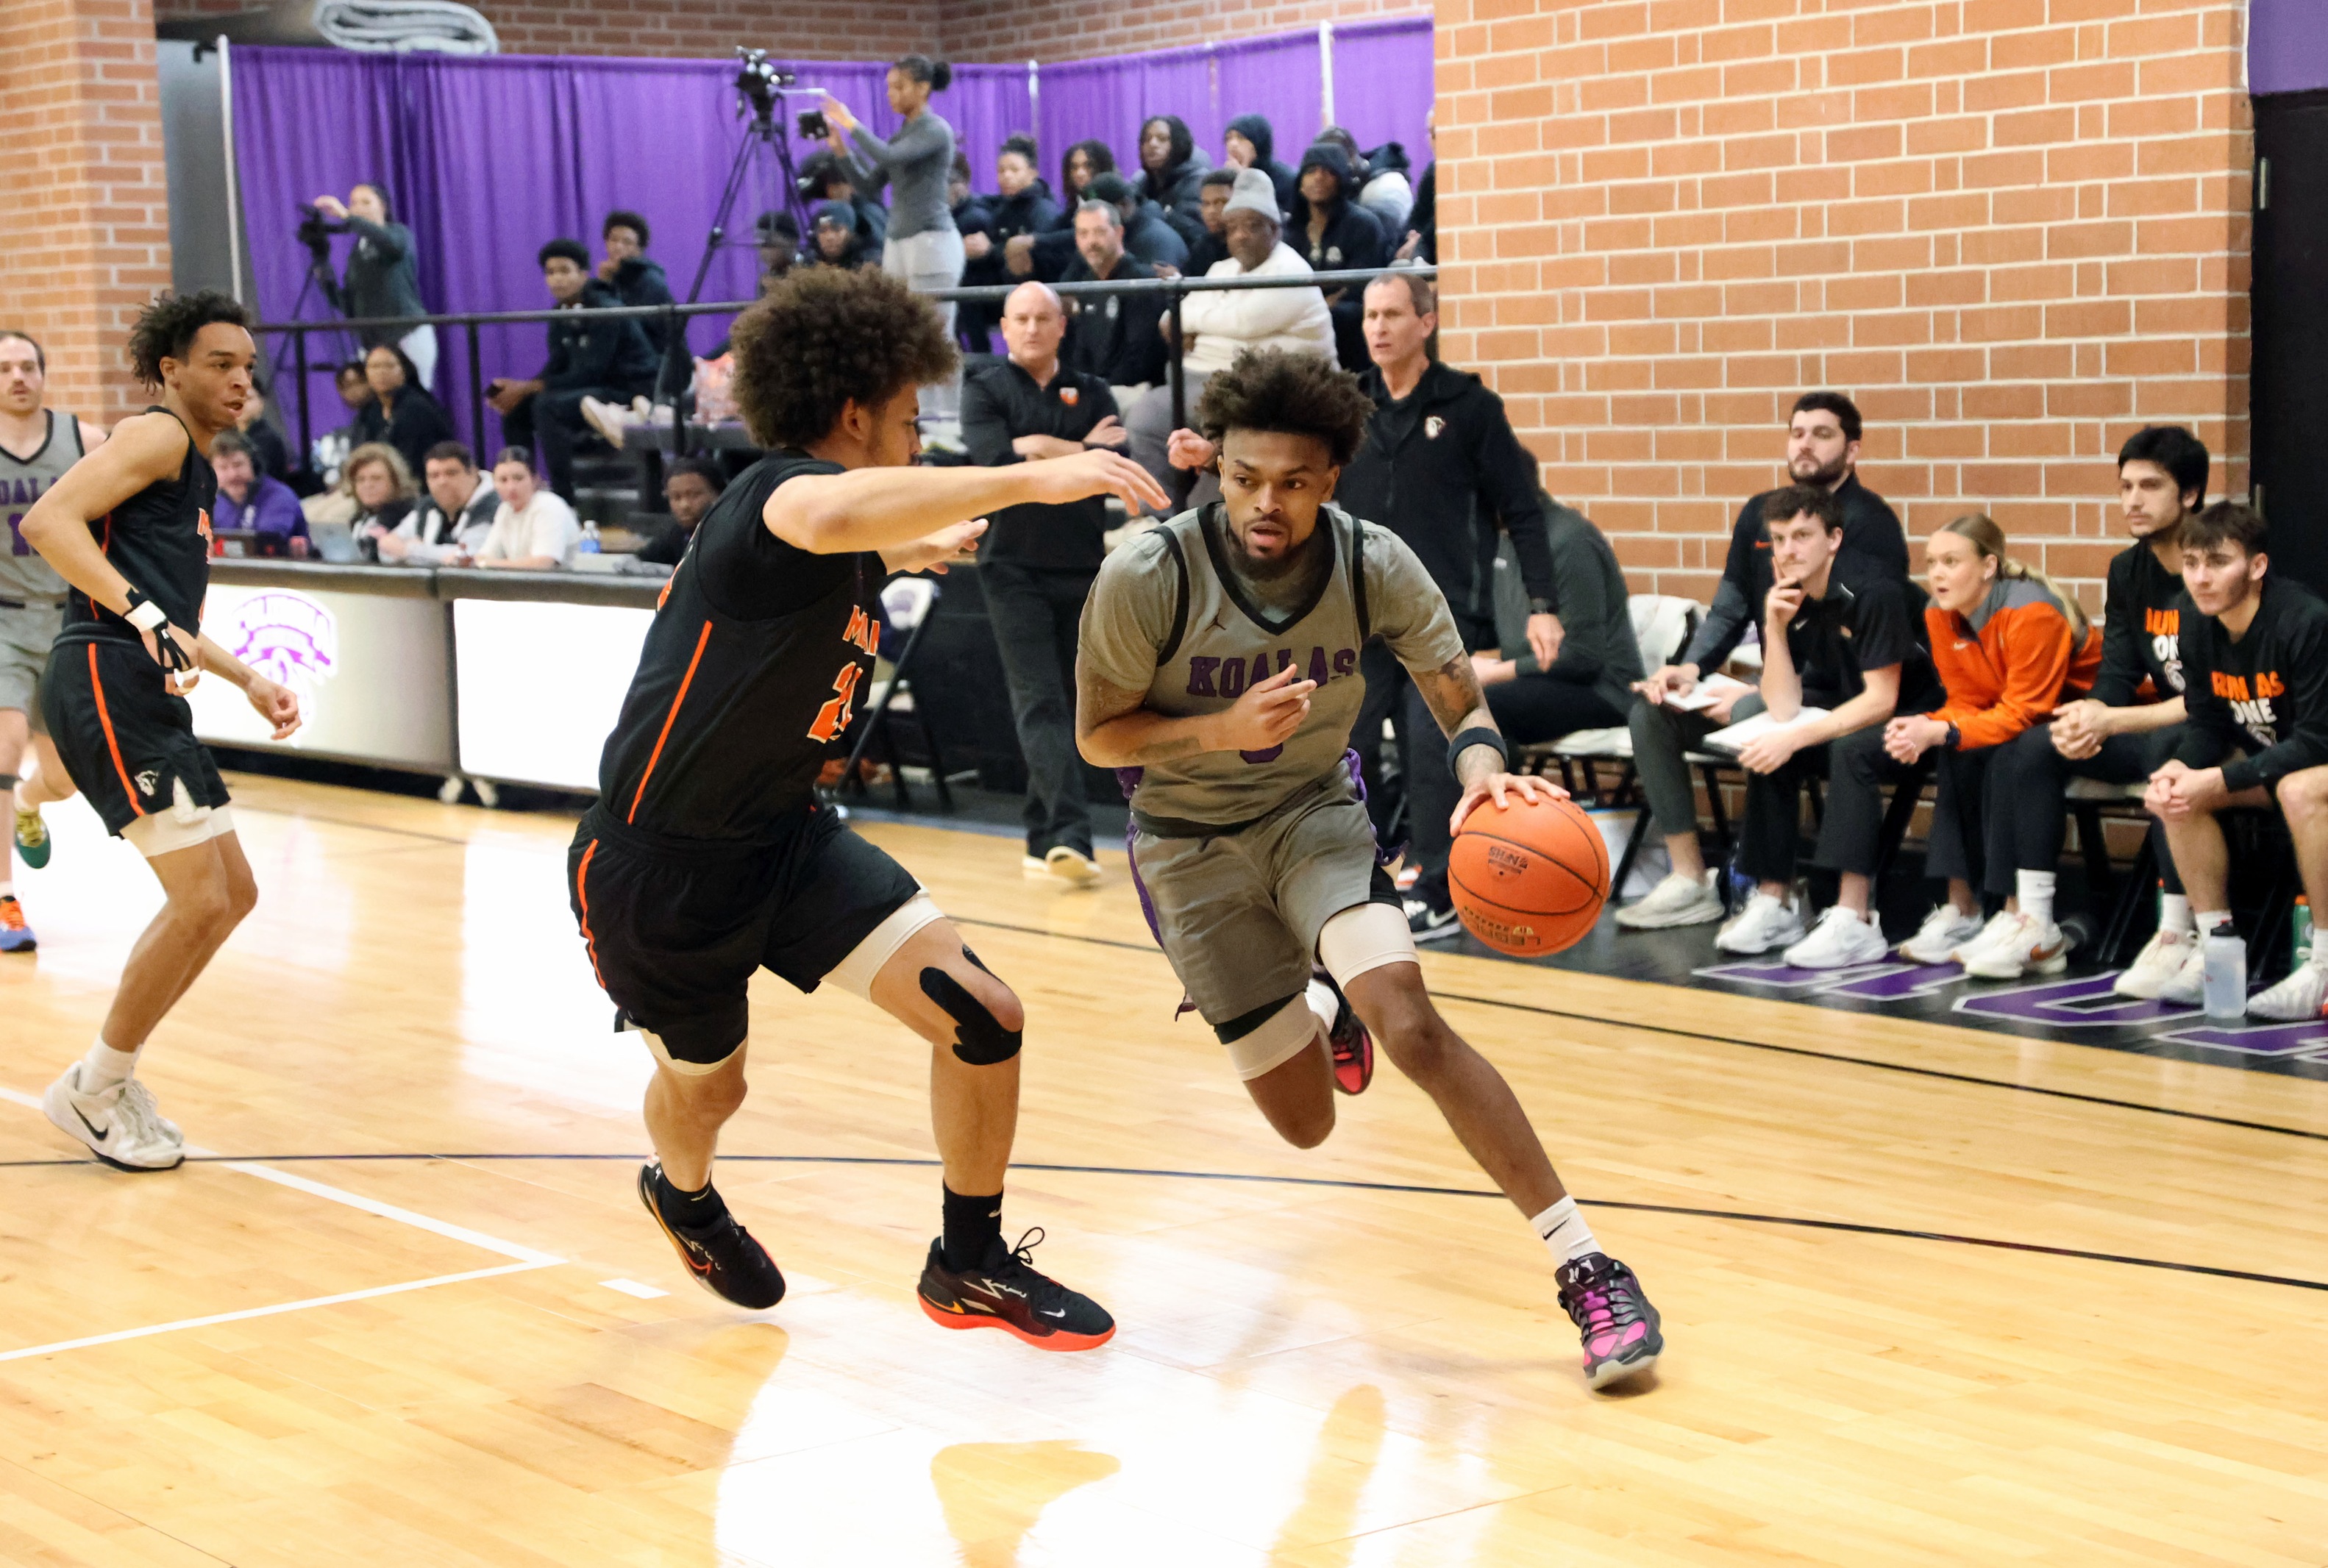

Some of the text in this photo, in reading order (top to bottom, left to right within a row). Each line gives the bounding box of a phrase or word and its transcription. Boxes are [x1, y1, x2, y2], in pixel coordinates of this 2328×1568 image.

[0, 477, 59, 505] OAL
[1186, 646, 1356, 698] KOALAS
[2211, 670, 2285, 703] RN AS
[2229, 698, 2277, 724] ONE
